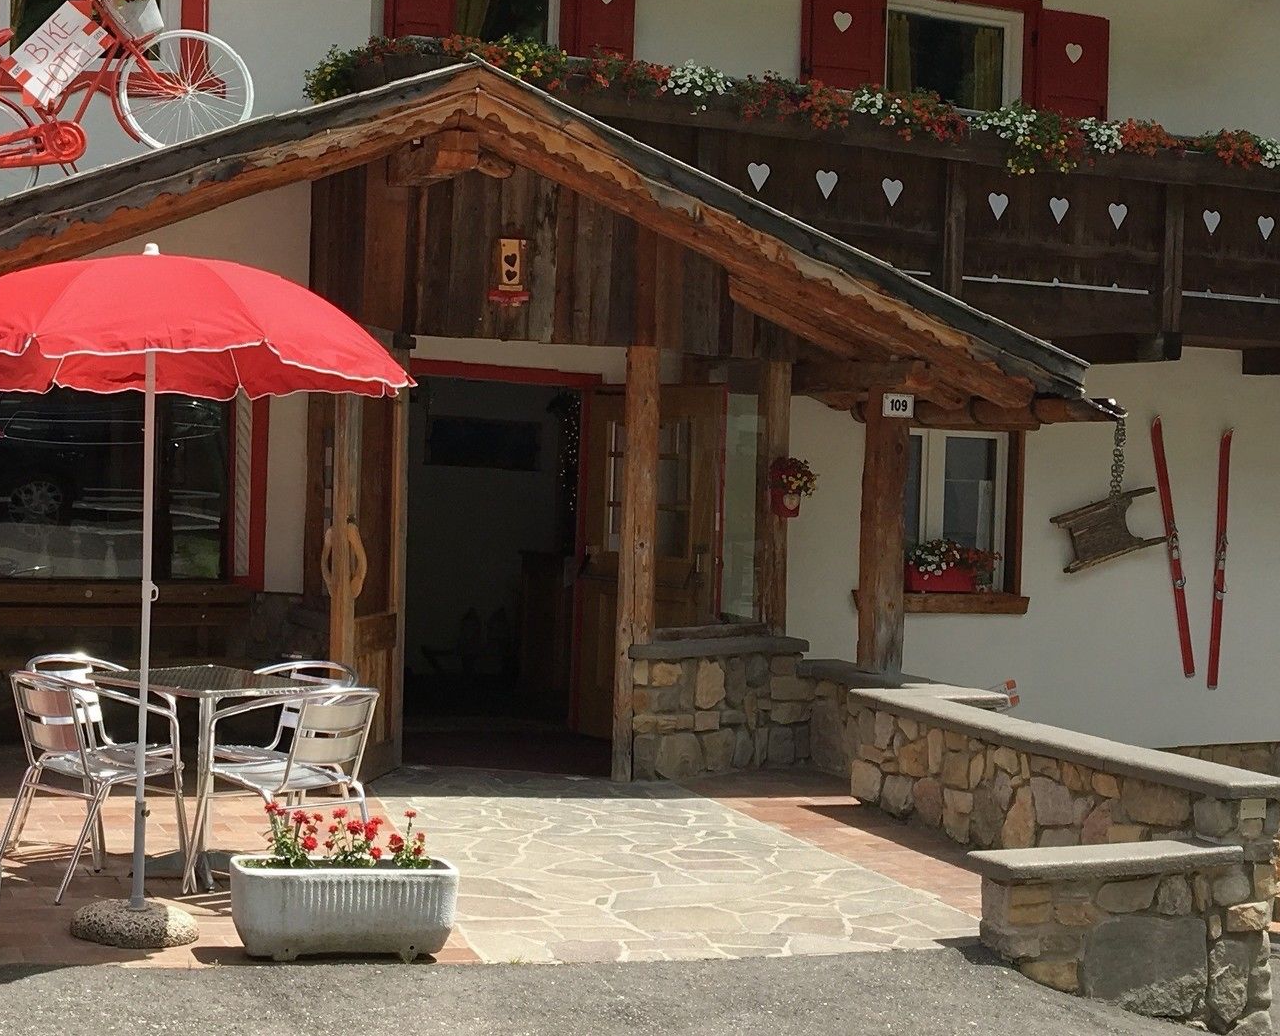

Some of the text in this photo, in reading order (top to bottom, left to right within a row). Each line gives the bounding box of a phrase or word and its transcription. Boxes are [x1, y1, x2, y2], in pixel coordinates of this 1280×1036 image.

[23, 13, 80, 65] BIKE
[36, 41, 101, 94] HOTEL
[890, 398, 908, 412] 109
